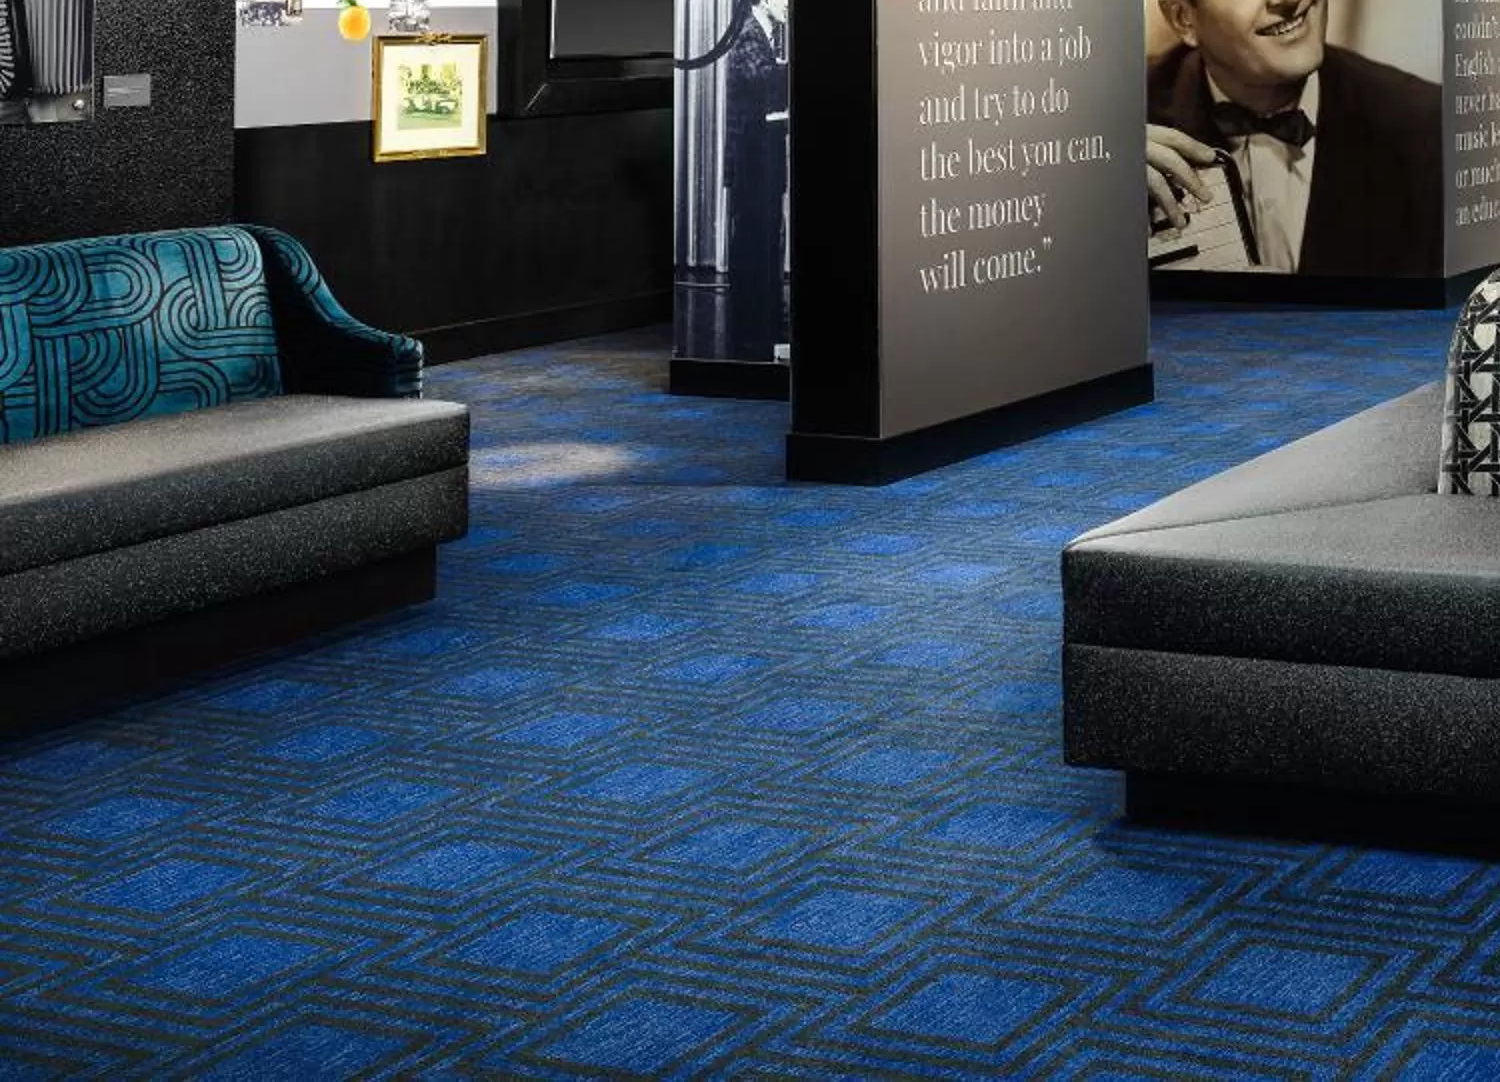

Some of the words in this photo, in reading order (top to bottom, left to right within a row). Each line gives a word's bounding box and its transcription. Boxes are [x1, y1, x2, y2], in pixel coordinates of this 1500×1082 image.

[918, 30, 984, 75] vigor
[988, 28, 1034, 66] into
[1040, 39, 1054, 61] a
[1056, 25, 1093, 68] job
[918, 84, 966, 125] and
[973, 84, 1005, 126] try
[1010, 85, 1036, 115] to
[1042, 77, 1071, 113] do
[919, 141, 962, 182] the
[967, 137, 1017, 178] best
[1021, 138, 1062, 177] you
[1066, 131, 1112, 164] can,
[919, 197, 962, 239] the
[967, 190, 1046, 232] money
[919, 248, 967, 295] will
